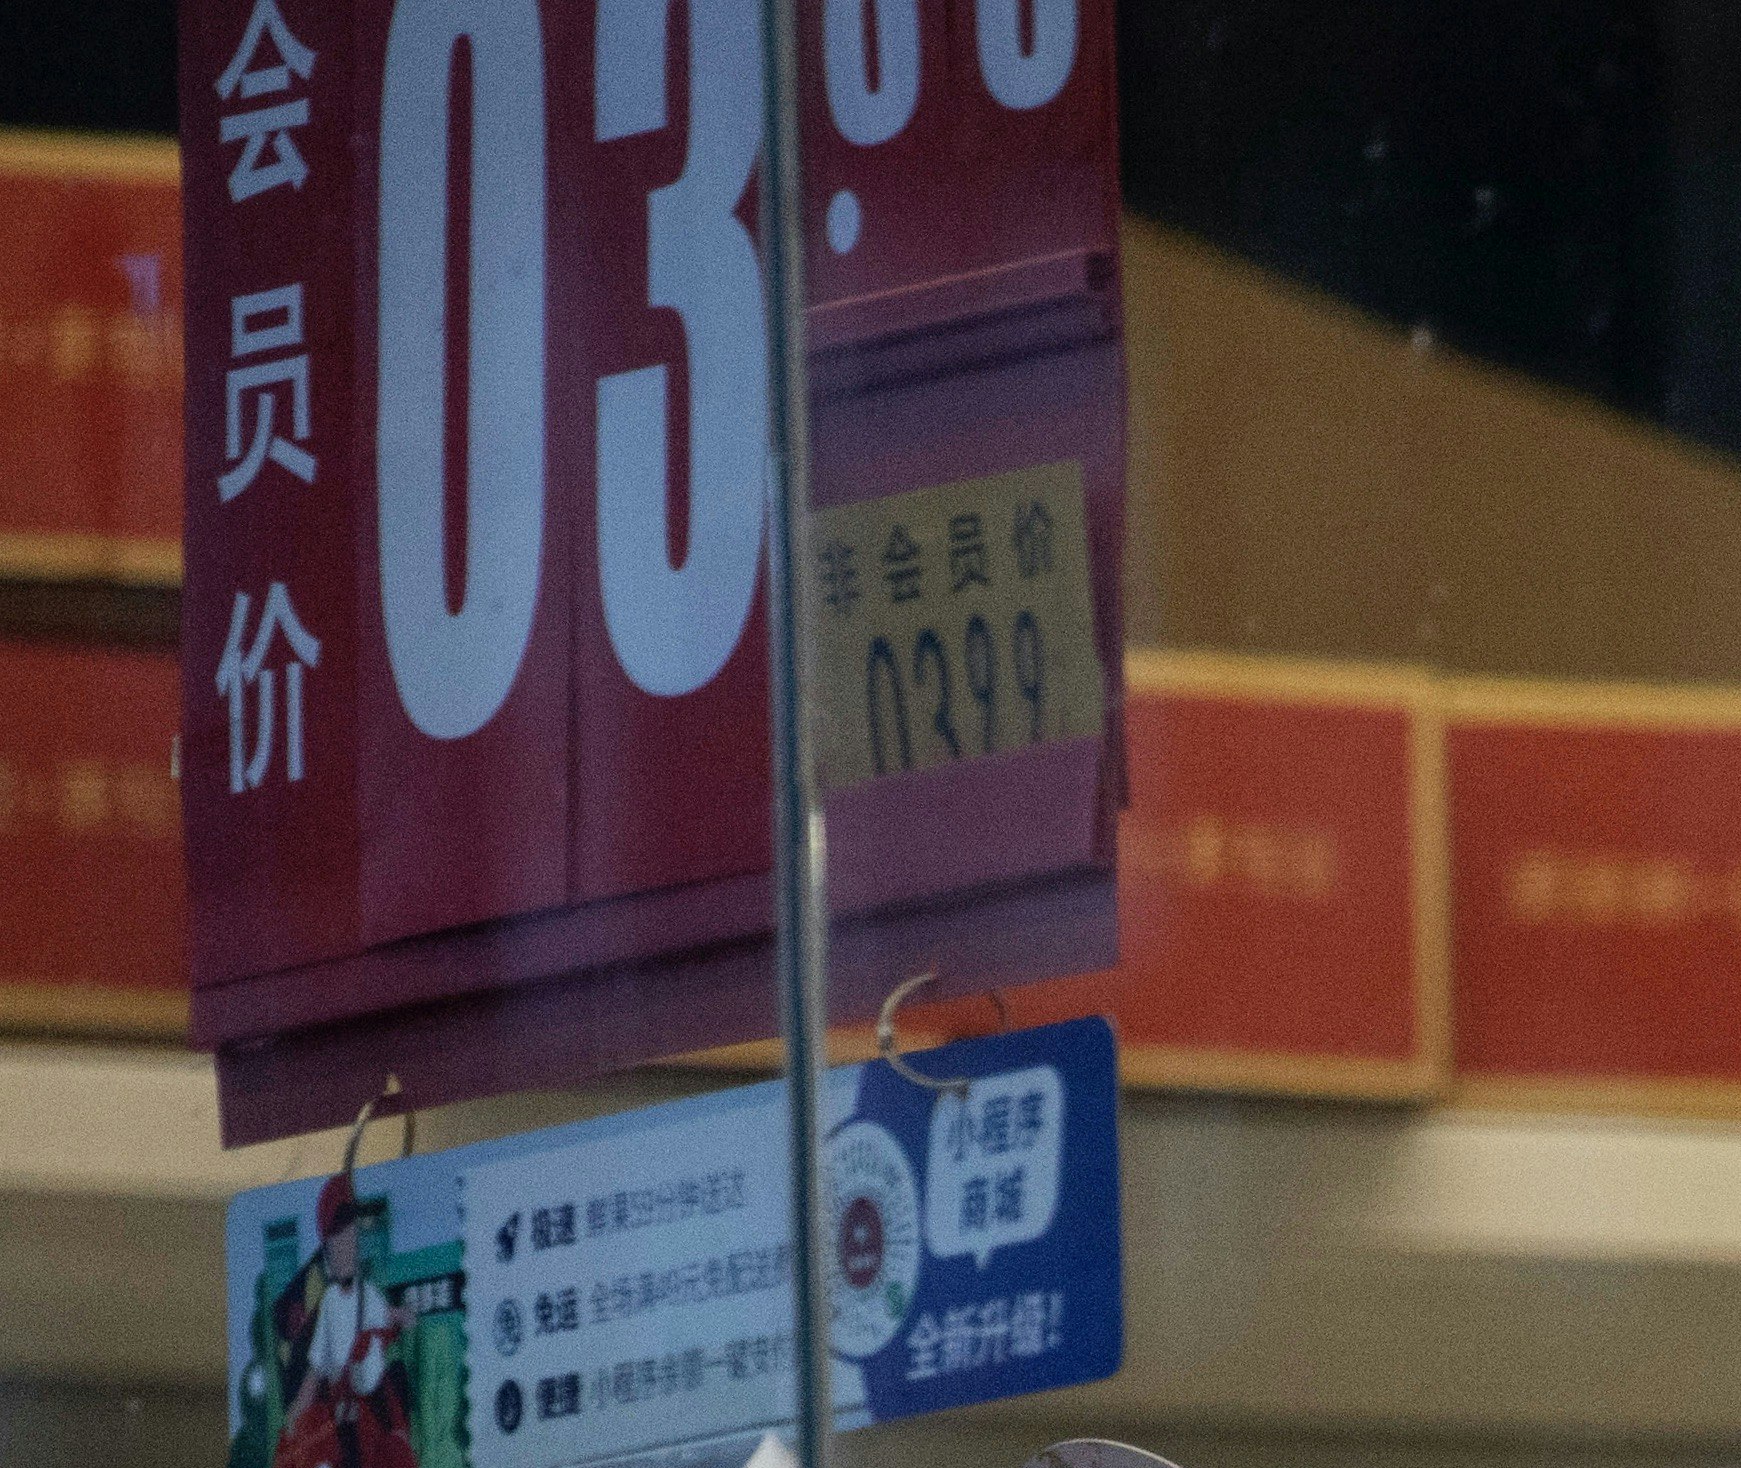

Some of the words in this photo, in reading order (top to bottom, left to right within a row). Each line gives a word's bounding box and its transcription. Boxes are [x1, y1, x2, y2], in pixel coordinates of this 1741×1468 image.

[214, 0, 322, 795] 会员价
[946, 1088, 1046, 1164] 小程序
[960, 1165, 1027, 1237] 商城
